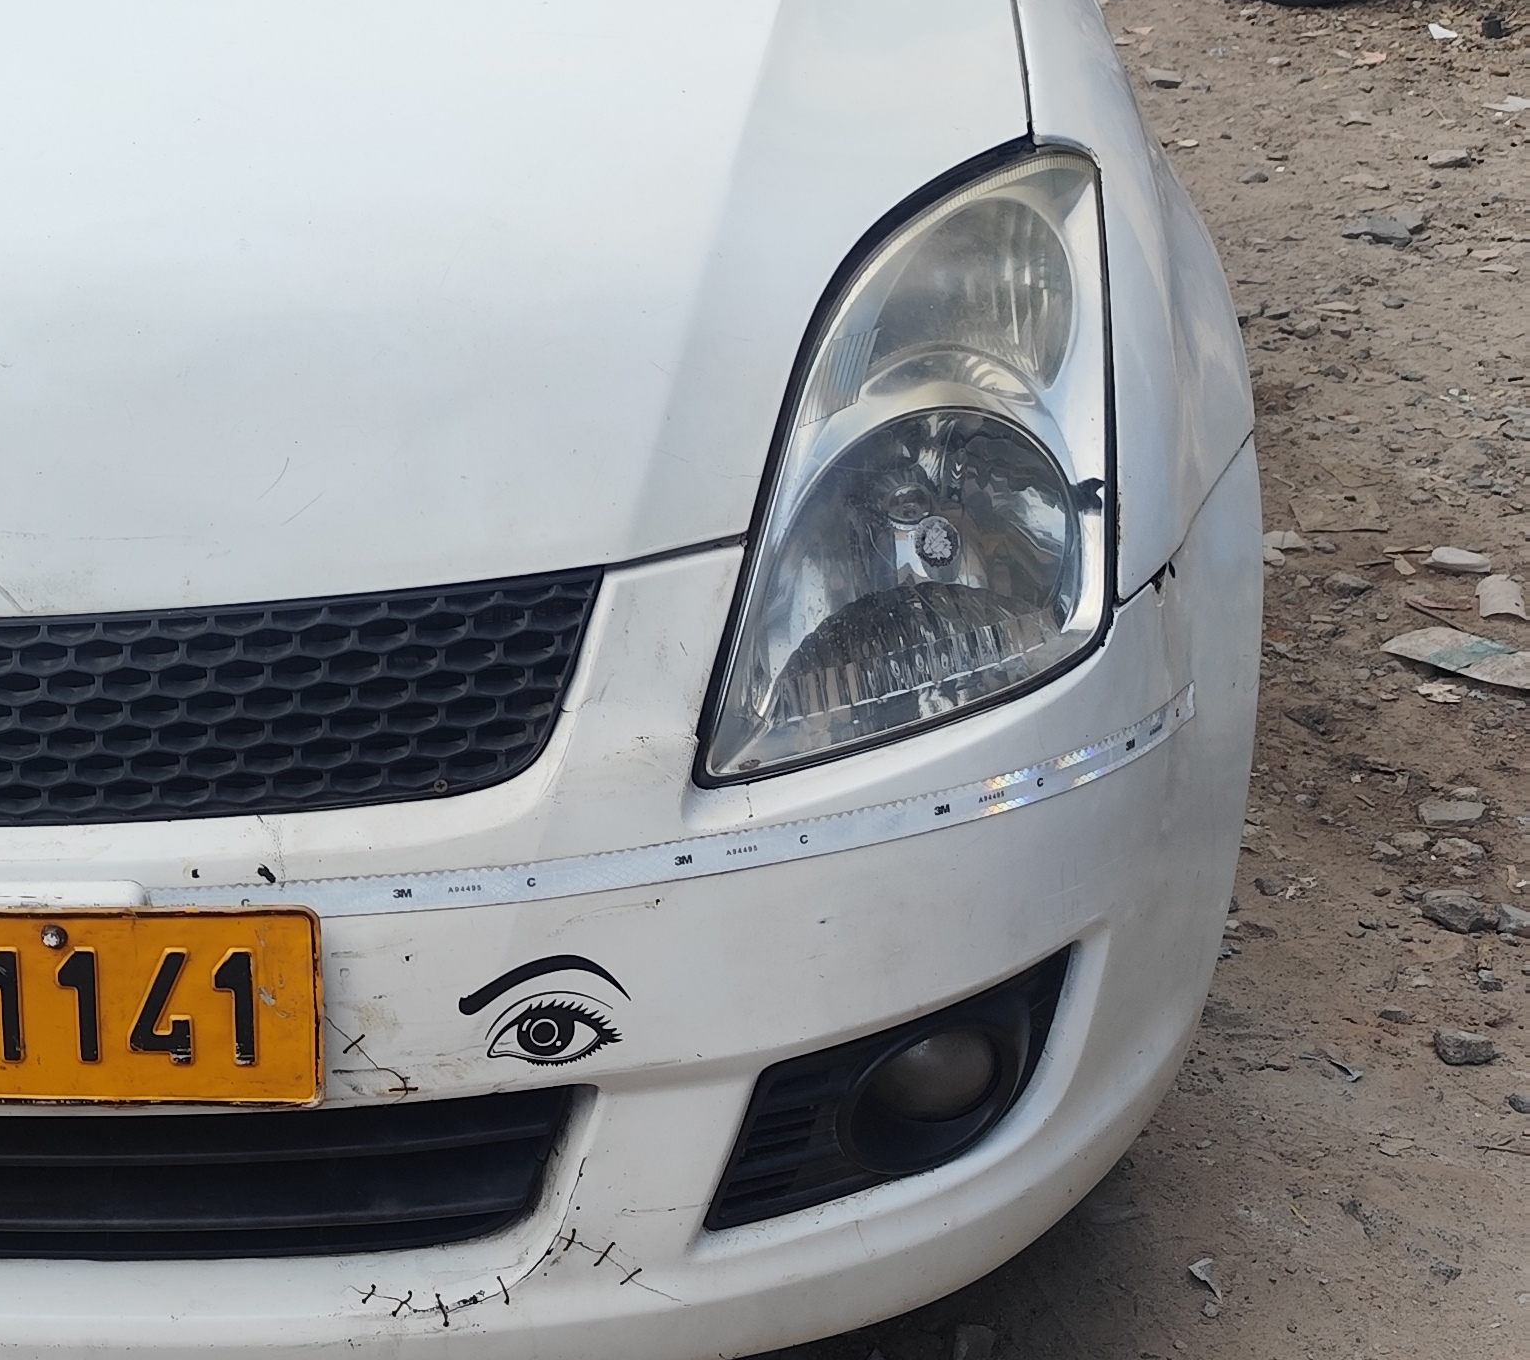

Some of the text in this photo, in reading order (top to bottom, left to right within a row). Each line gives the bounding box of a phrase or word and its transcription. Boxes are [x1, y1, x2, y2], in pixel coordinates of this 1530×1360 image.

[392, 888, 412, 899] 3M
[526, 877, 536, 887] C
[674, 854, 692, 866] 3M
[726, 845, 758, 856] A94495
[799, 834, 809, 844] C
[934, 804, 950, 816] 3M
[1036, 778, 1044, 787] C
